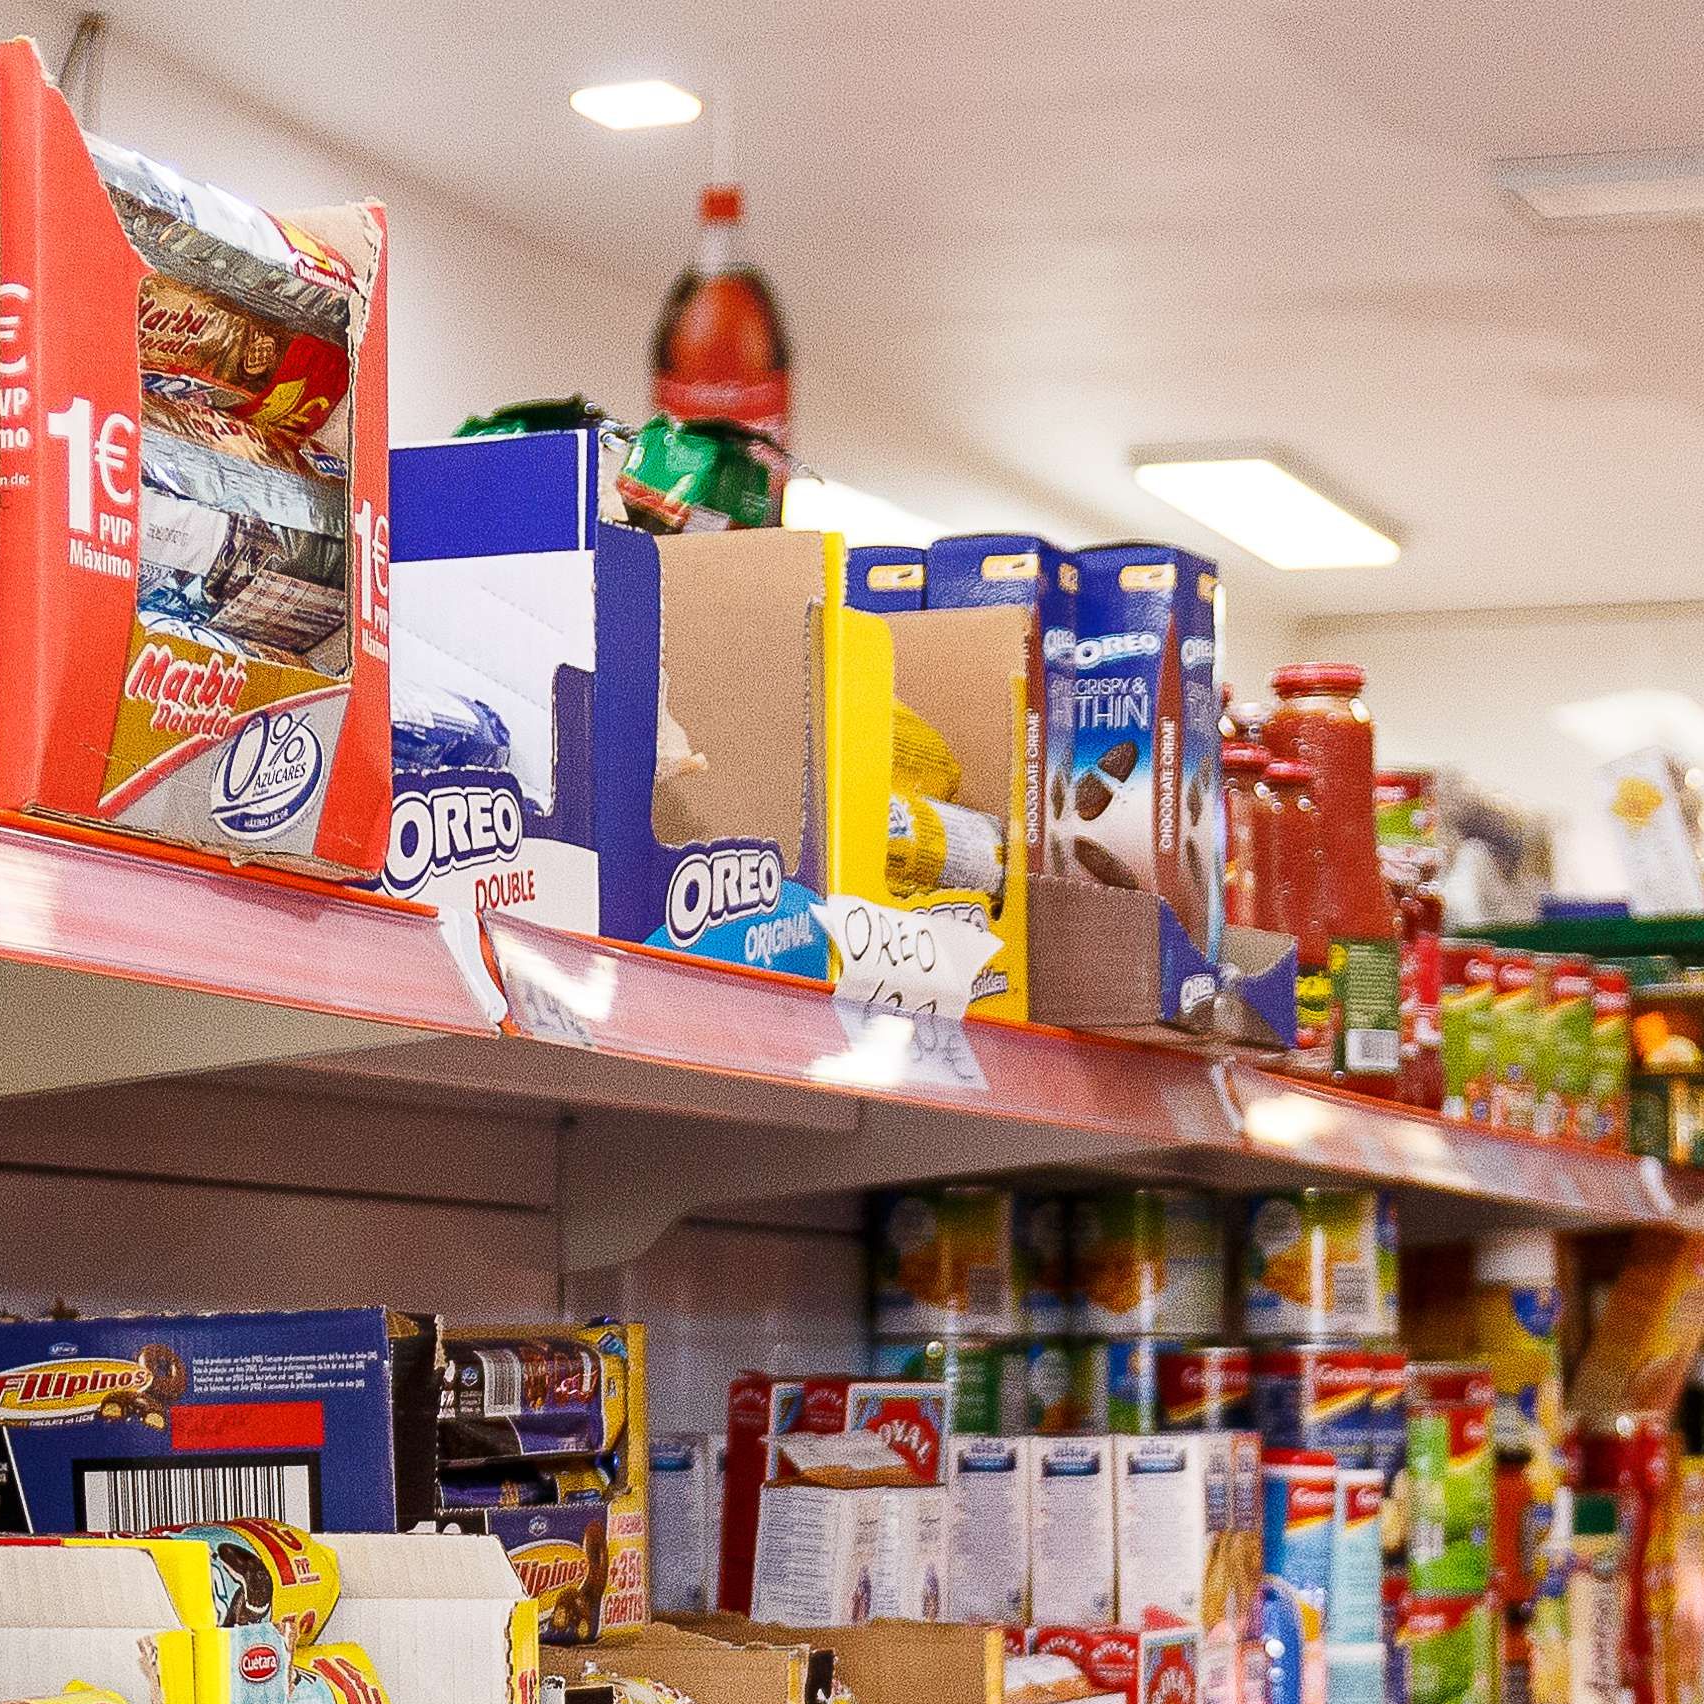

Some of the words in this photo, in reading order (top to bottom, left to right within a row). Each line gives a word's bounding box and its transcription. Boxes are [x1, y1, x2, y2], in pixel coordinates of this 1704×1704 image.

[46, 396, 136, 535] 1€
[99, 516, 133, 548] PVP
[68, 538, 133, 580] Máximo
[1073, 632, 1159, 668] OREO
[128, 645, 247, 710] Marbú
[1074, 676, 1128, 699] CRISPY
[152, 703, 233, 740] Dorada
[1072, 697, 1150, 730] THIN
[254, 764, 307, 789] AZÚCARES
[389, 792, 521, 890] OREO
[473, 868, 536, 912] DOUBLE
[670, 851, 781, 940] OREO
[744, 911, 815, 965] ORIGINAL
[241, 1651, 279, 1674] Cuétara
